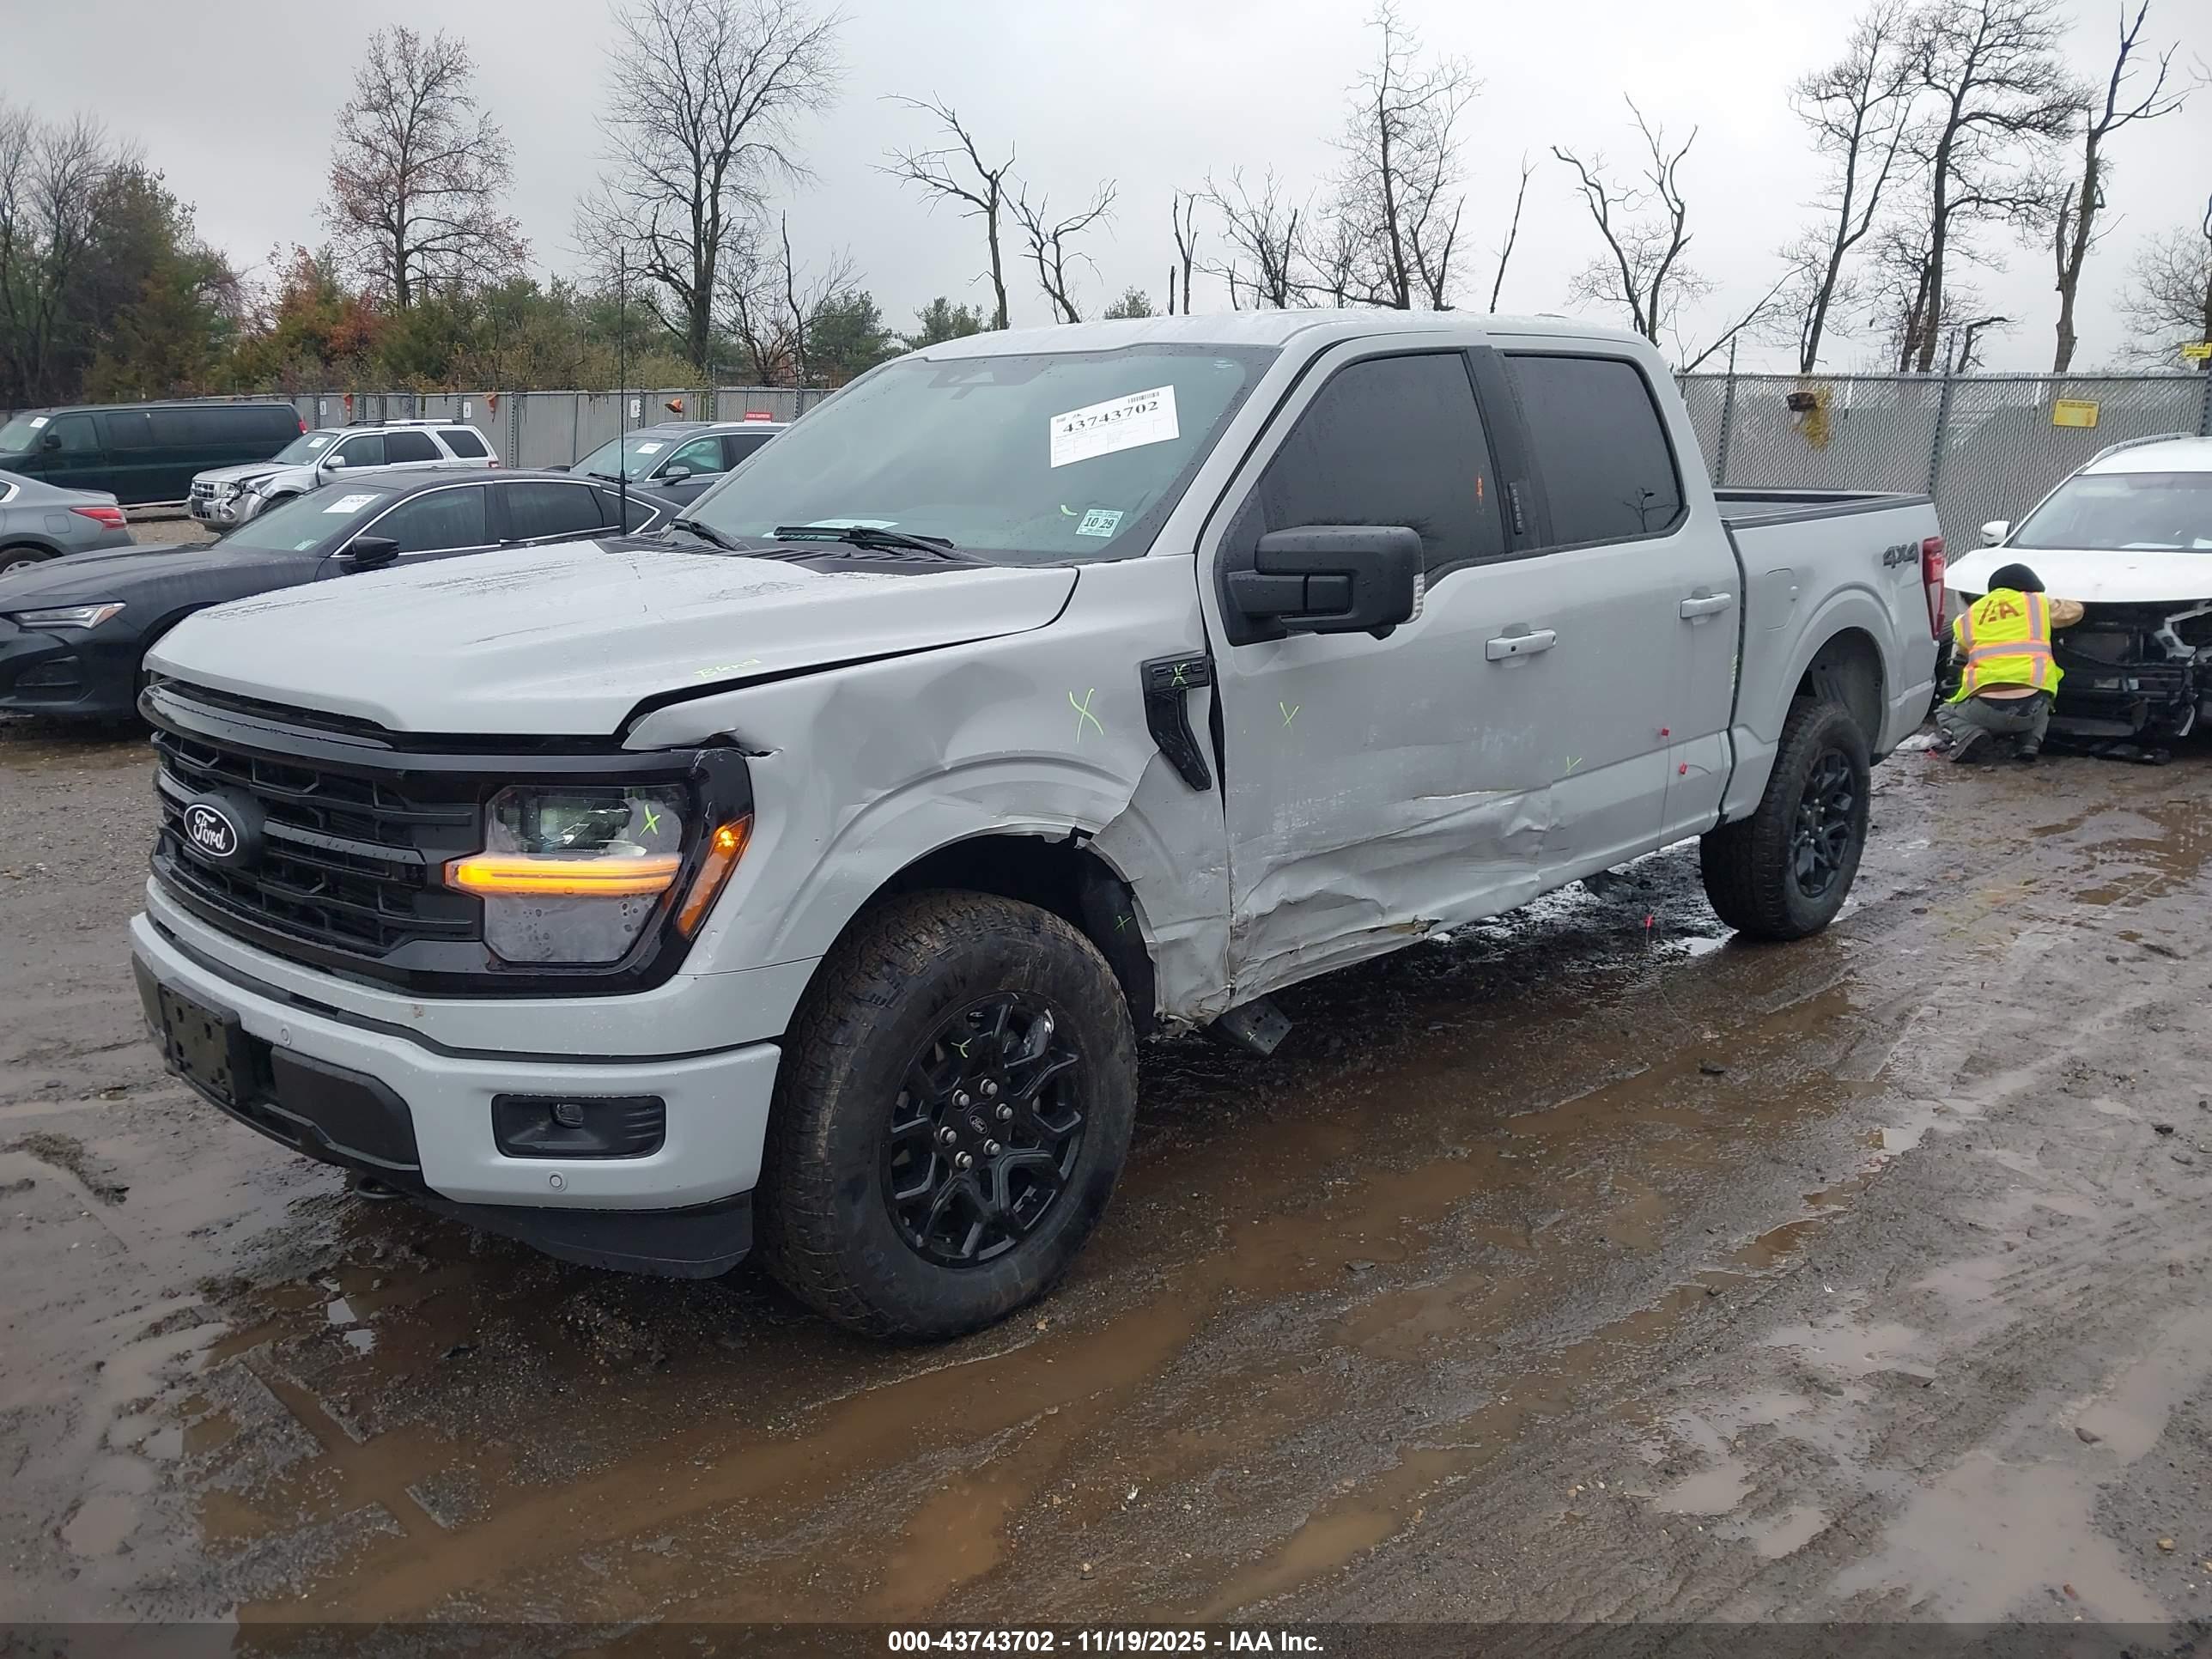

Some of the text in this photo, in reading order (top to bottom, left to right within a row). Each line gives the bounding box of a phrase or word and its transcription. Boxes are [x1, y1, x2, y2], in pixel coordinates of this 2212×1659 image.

[1062, 401, 1158, 433] 43743702
[1084, 517, 1115, 529] 10 29
[193, 810, 226, 850] Ford
